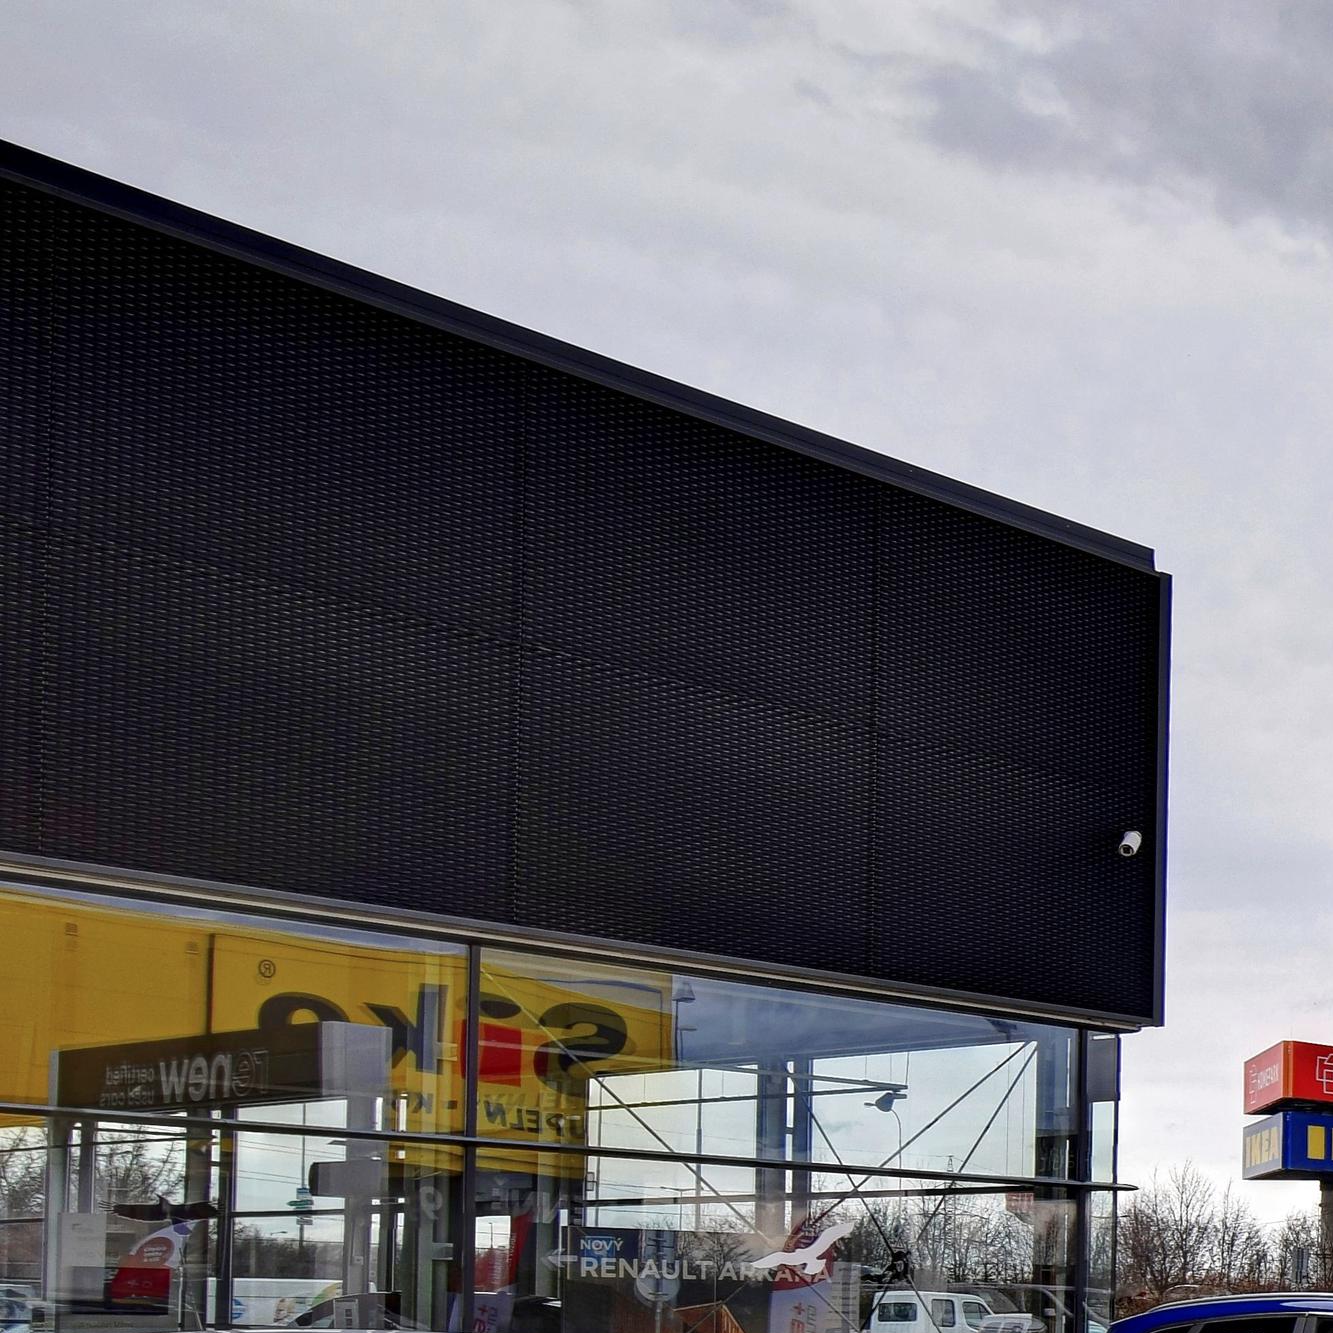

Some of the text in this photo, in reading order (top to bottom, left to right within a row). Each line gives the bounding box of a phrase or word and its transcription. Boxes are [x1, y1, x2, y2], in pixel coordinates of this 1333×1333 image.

[1245, 1126, 1279, 1169] IKEA
[580, 1237, 624, 1251] NOVÝ
[580, 1257, 715, 1281] RENAULT
